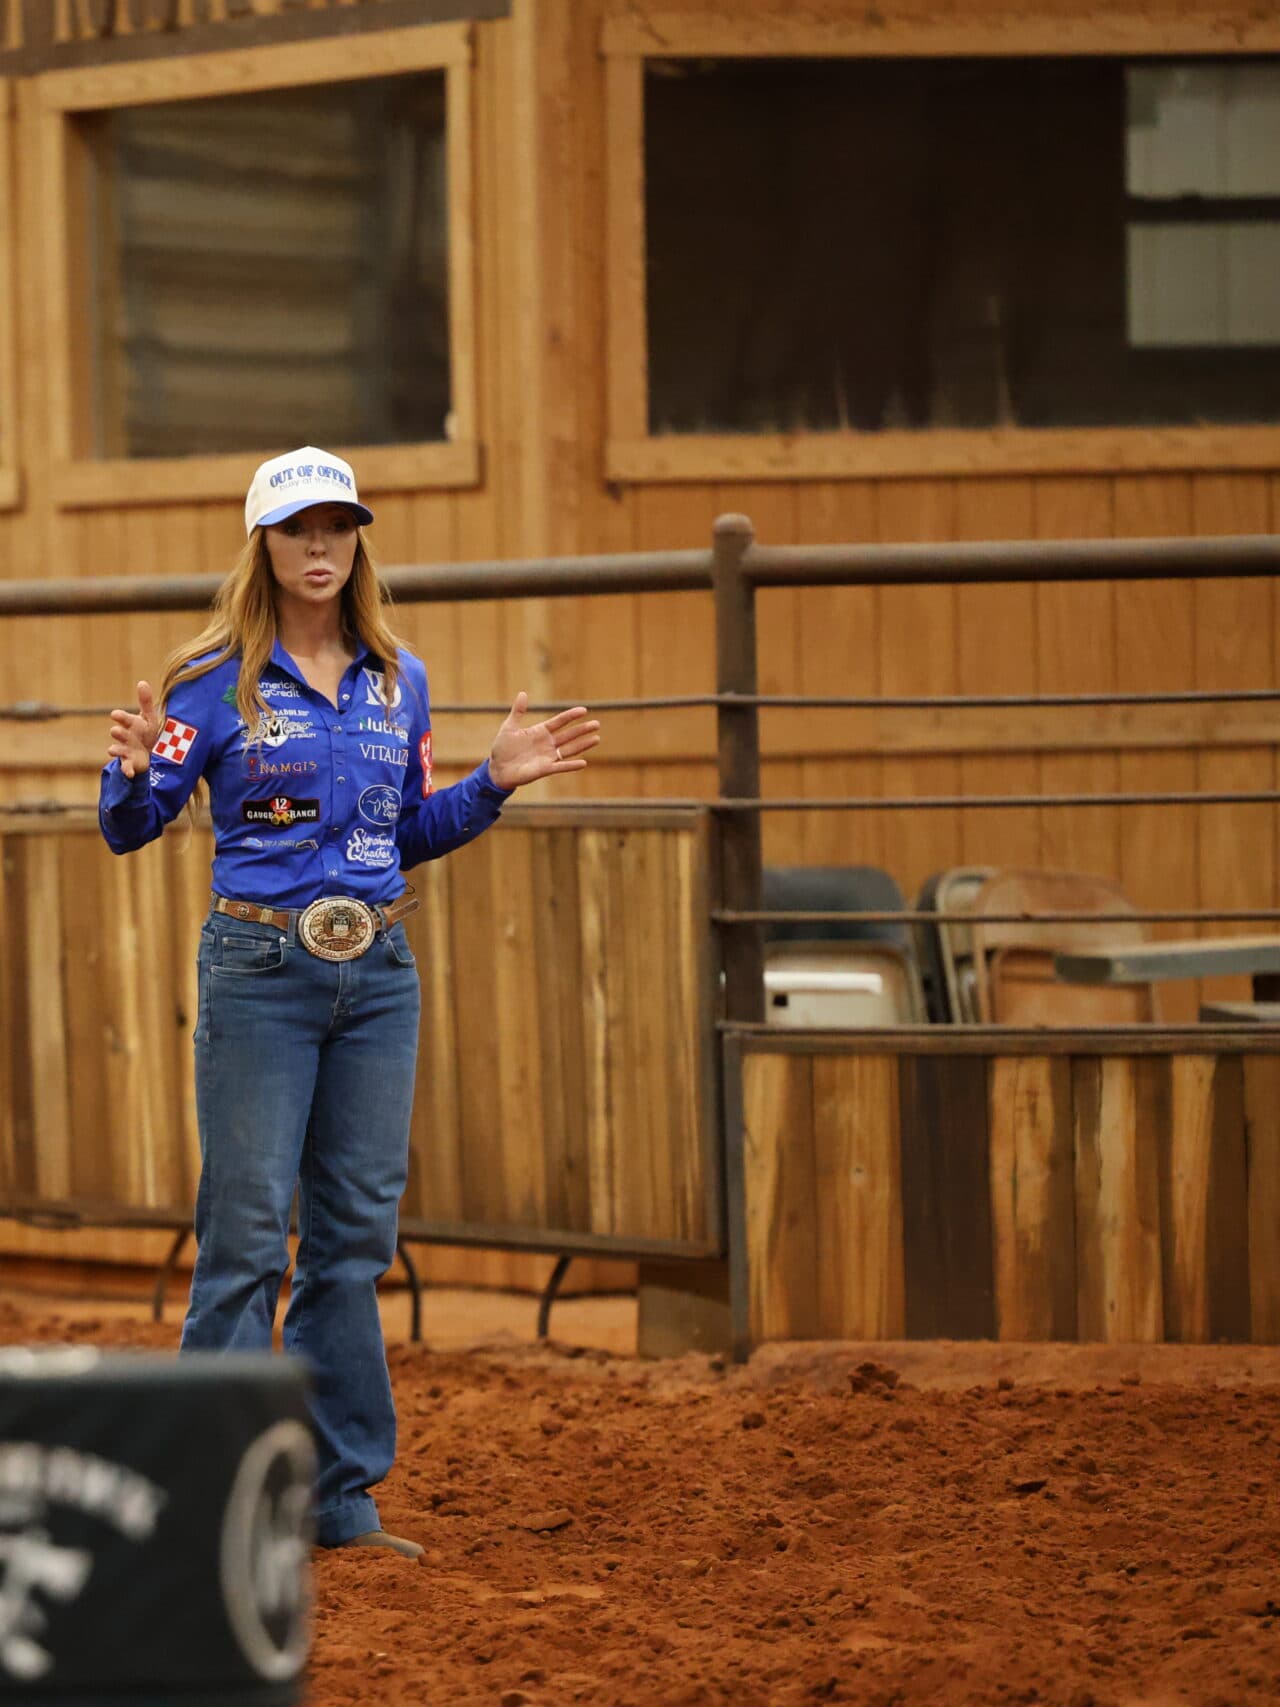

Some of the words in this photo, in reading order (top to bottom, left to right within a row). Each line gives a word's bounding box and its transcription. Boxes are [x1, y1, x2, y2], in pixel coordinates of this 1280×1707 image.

[270, 467, 294, 488] OUT
[297, 465, 314, 477] OF
[317, 465, 352, 490] OFFICE
[274, 797, 288, 810] 12
[247, 810, 274, 820] GAUGE
[288, 808, 317, 819] RANCH
